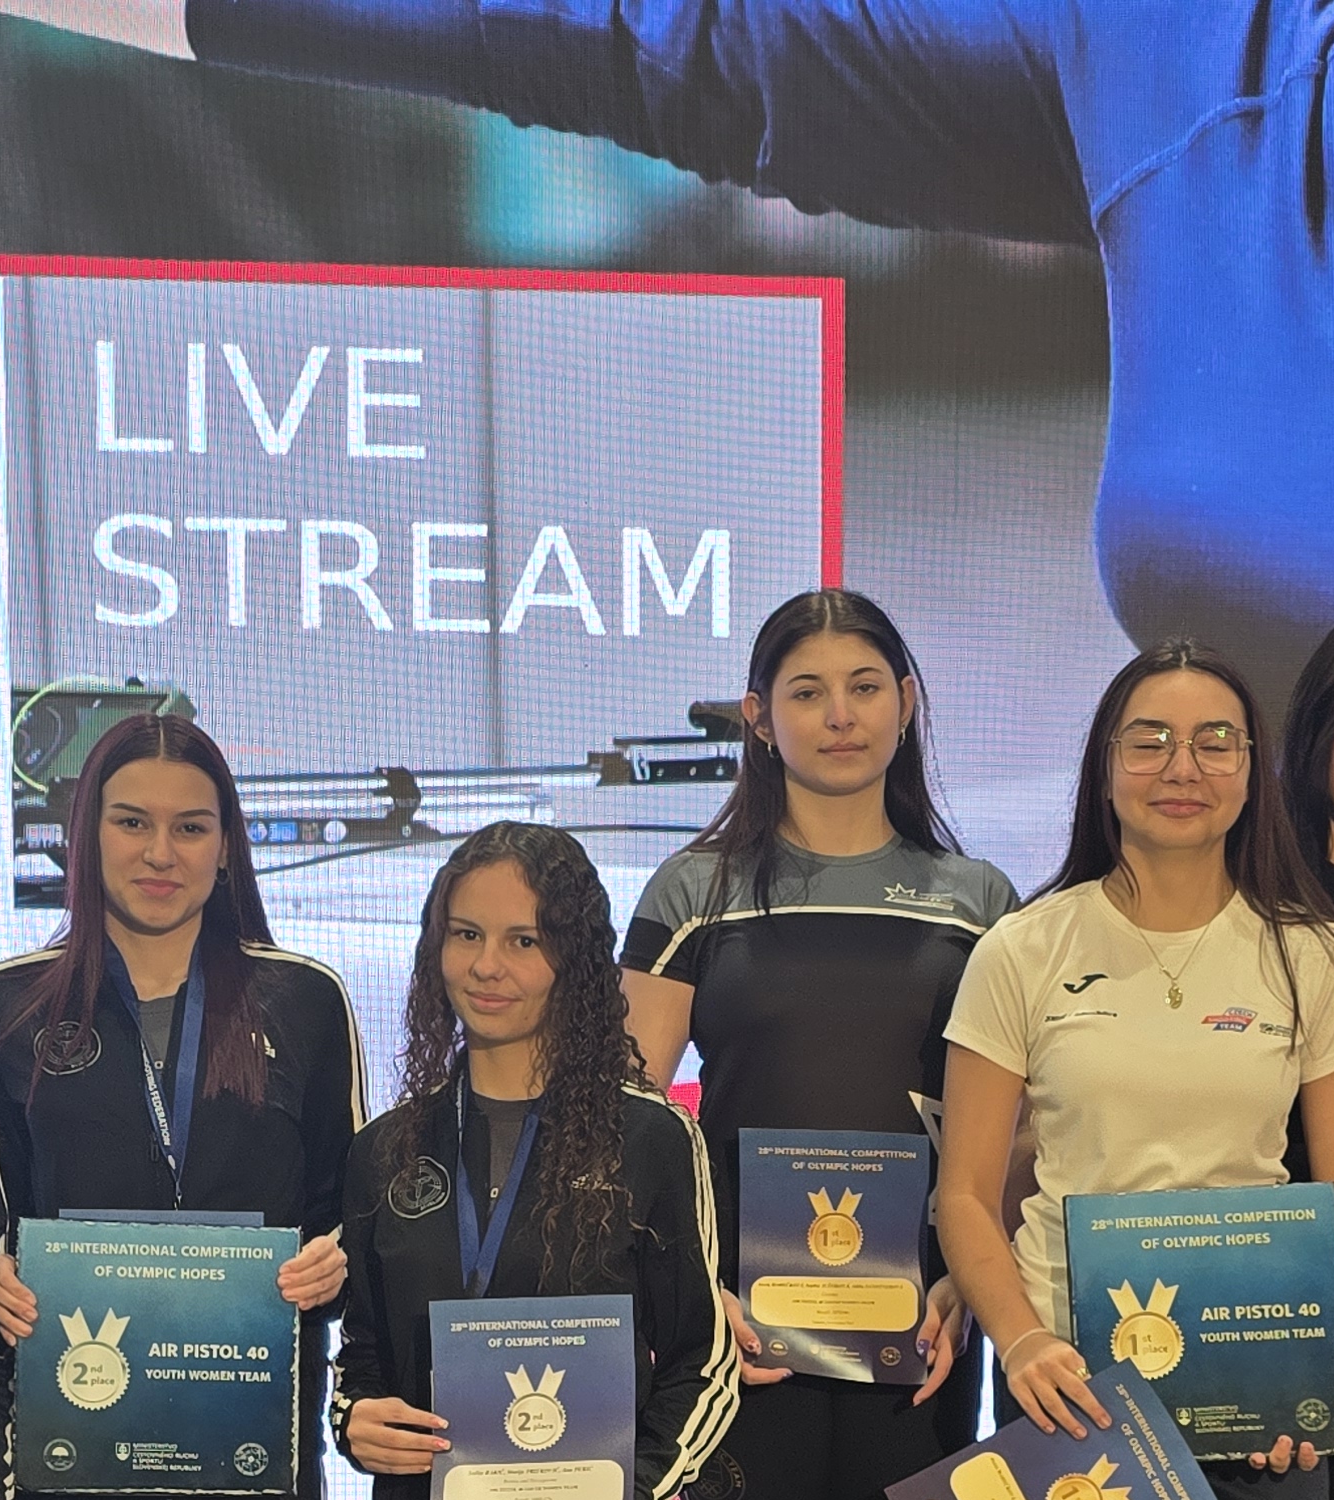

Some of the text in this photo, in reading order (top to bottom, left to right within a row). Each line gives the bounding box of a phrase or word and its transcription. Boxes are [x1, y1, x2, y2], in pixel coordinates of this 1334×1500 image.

[95, 339, 426, 460] LIVE
[93, 511, 731, 638] STREAM
[150, 1090, 171, 1146] FEDERATION
[775, 1147, 849, 1158] INTERNATIONAL
[852, 1149, 916, 1159] COMPETITION
[792, 1161, 883, 1172] OF OLYMPIC HOPES
[1115, 1214, 1220, 1229] INTERNATIONAL
[1224, 1209, 1316, 1224] COMPETITION
[1141, 1233, 1270, 1249] OF OLYMPIC HOPES
[45, 1241, 273, 1260] 28th INTERNATIONAL COMPETITION
[94, 1266, 226, 1280] OF OLYMPIC HOPES
[1201, 1303, 1320, 1321] AIR PISTOL 40
[469, 1319, 548, 1331] INTERNATIONAL
[552, 1318, 620, 1328] COMPETITION
[488, 1335, 586, 1348] OF OLYMPIC HOPES
[1200, 1327, 1325, 1343] YOUTH WOMEN TEAM
[148, 1343, 269, 1360] AIR PISTOL 40
[1142, 1344, 1168, 1355] place
[90, 1376, 115, 1387] place
[145, 1369, 271, 1382] YOUTH WOMEN TEAM
[1125, 1397, 1170, 1472] INTERNATIONAL
[1120, 1423, 1134, 1439] OF
[1128, 1437, 1156, 1480] OLYMPIC
